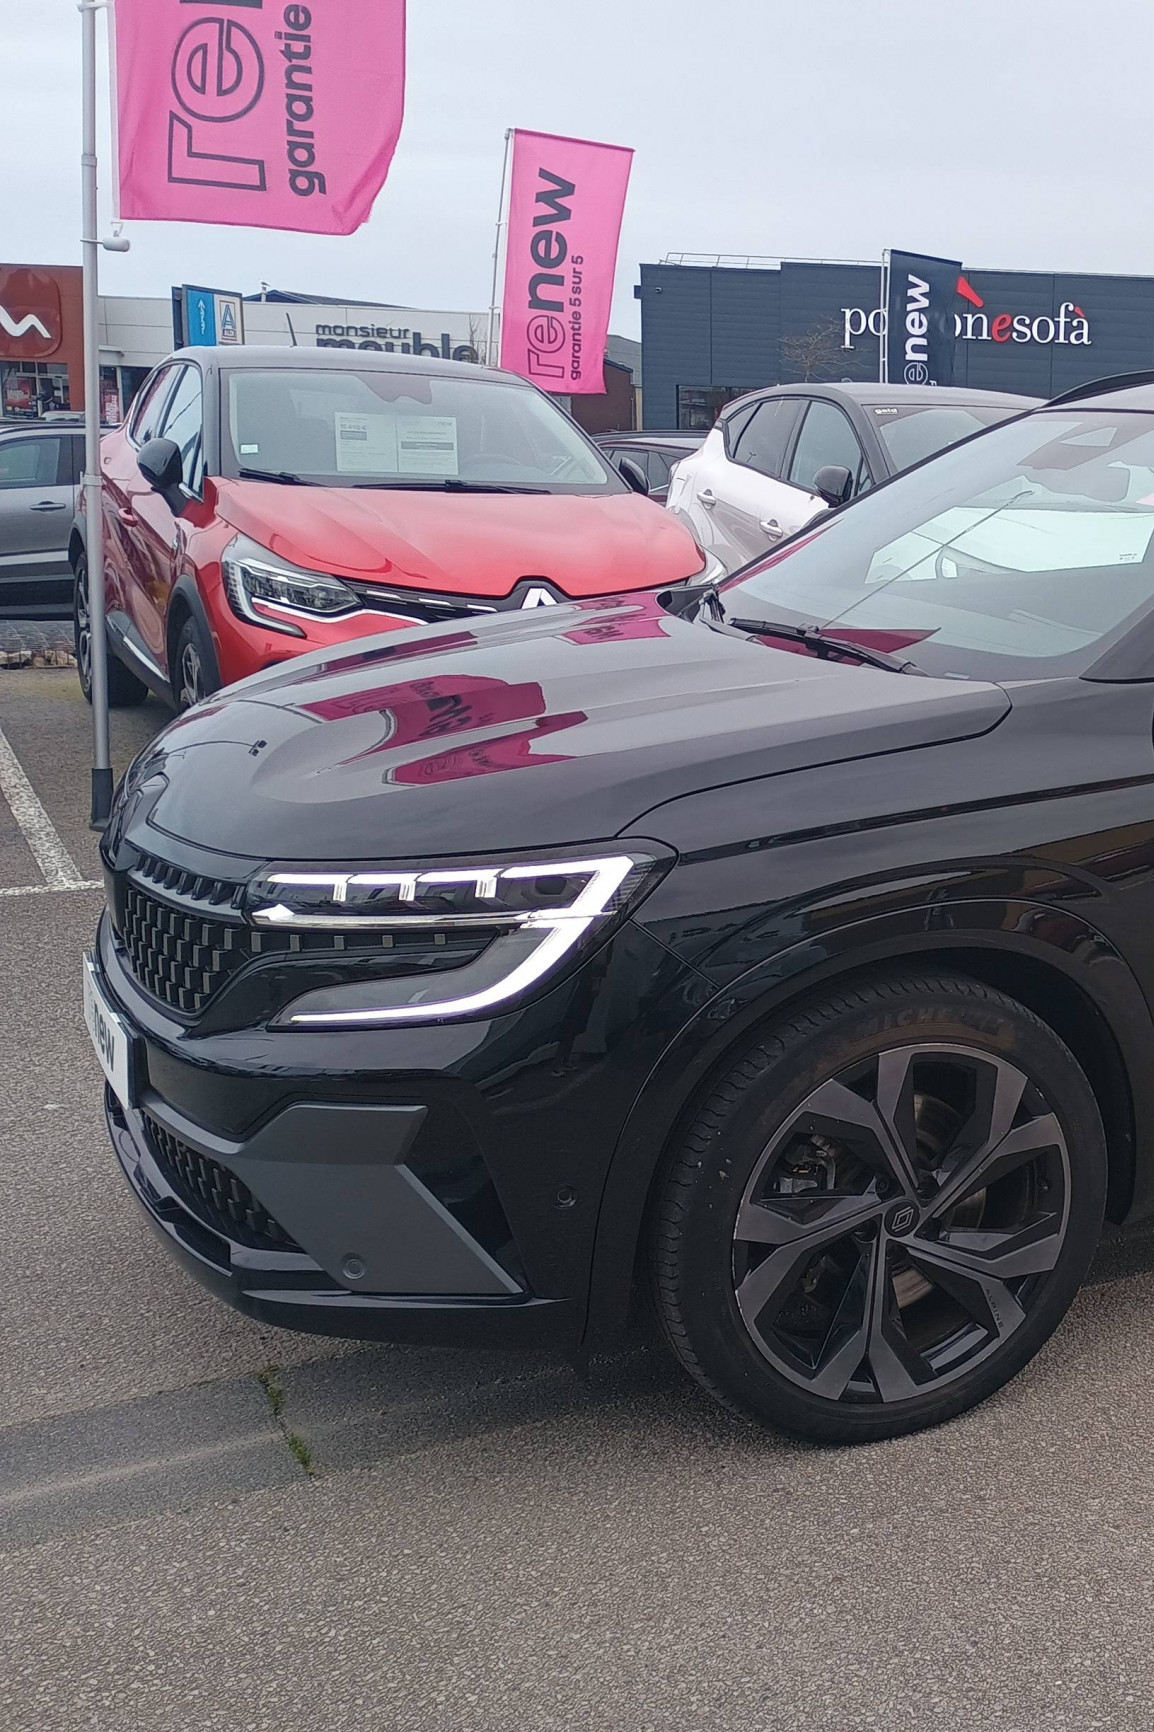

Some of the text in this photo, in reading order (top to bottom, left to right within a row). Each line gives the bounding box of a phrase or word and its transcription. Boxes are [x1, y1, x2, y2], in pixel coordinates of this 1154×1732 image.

[168, 0, 266, 191] re
[274, 3, 326, 196] garantie
[315, 323, 410, 339] monsieur
[527, 167, 576, 379] renew
[568, 255, 584, 381] garantie 5 sur 5
[903, 274, 930, 385] enew
